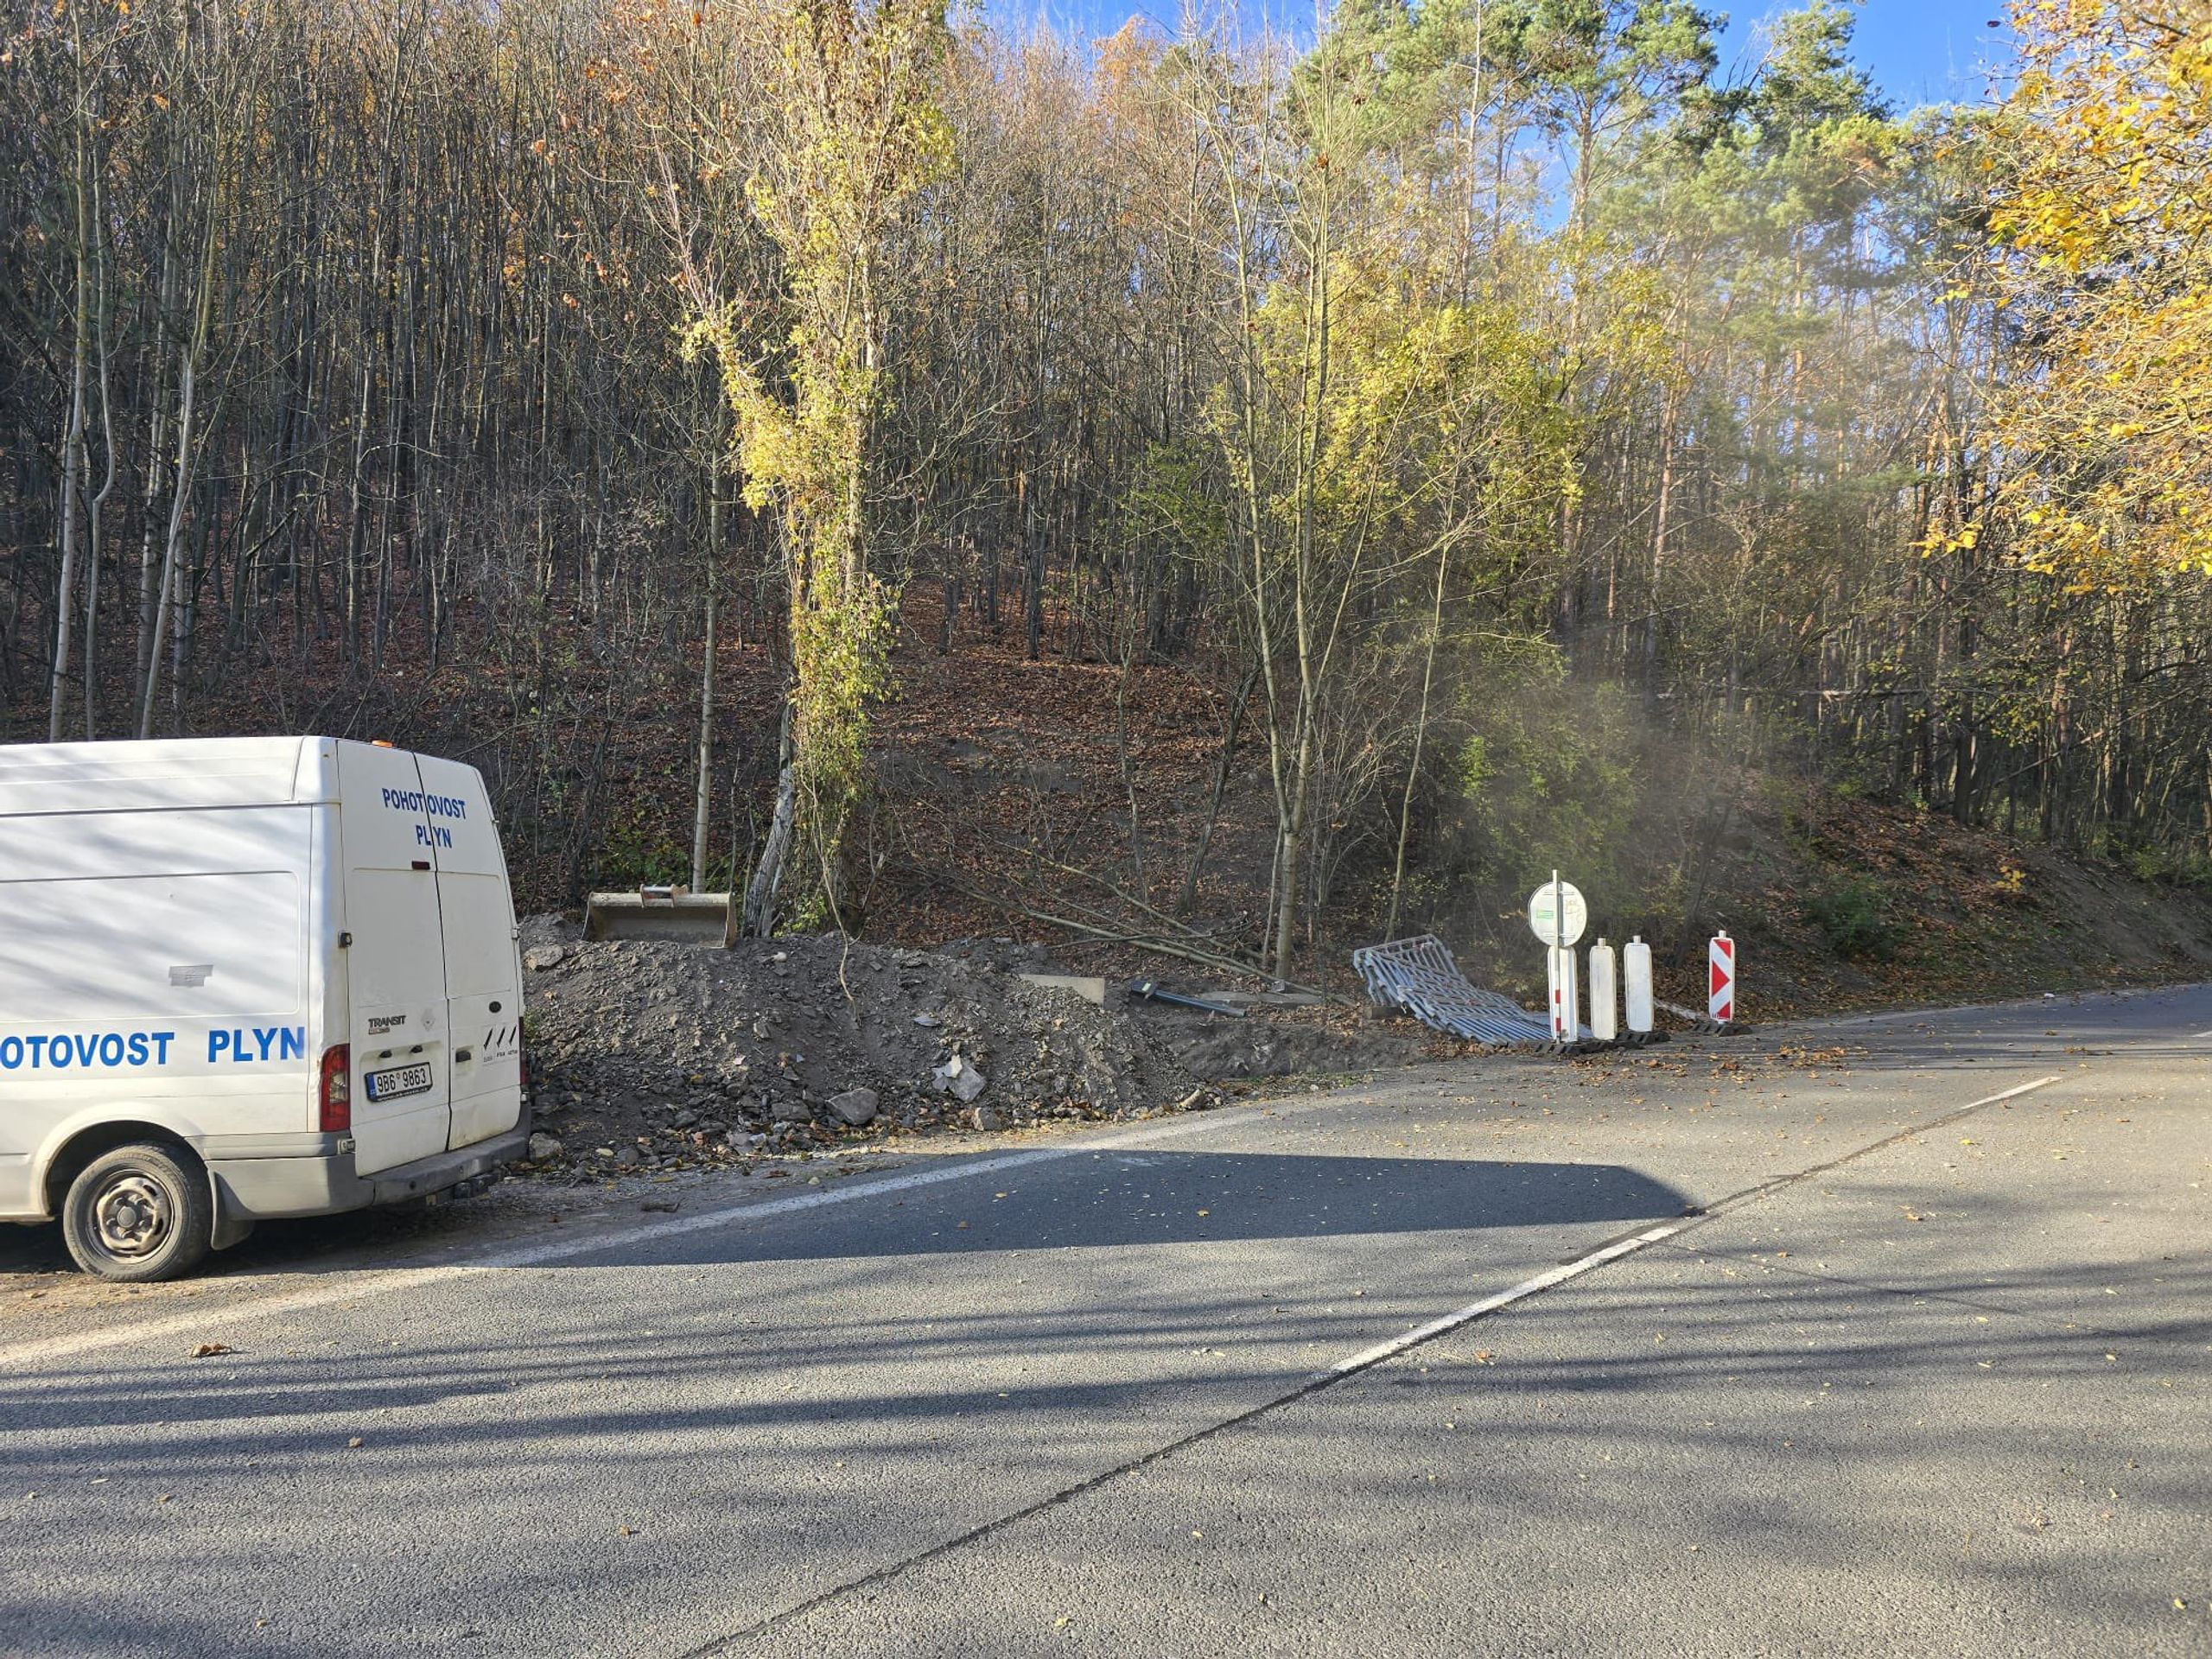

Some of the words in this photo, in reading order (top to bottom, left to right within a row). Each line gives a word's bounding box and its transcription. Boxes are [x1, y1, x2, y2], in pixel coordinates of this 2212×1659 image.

[382, 788, 466, 819] POHOTOVOST
[416, 825, 452, 849] PLYN
[368, 1015, 406, 1028] TRANSIT
[207, 1027, 305, 1063] PLYN
[377, 1074, 396, 1093] 9B6
[402, 1068, 426, 1087] 9863
